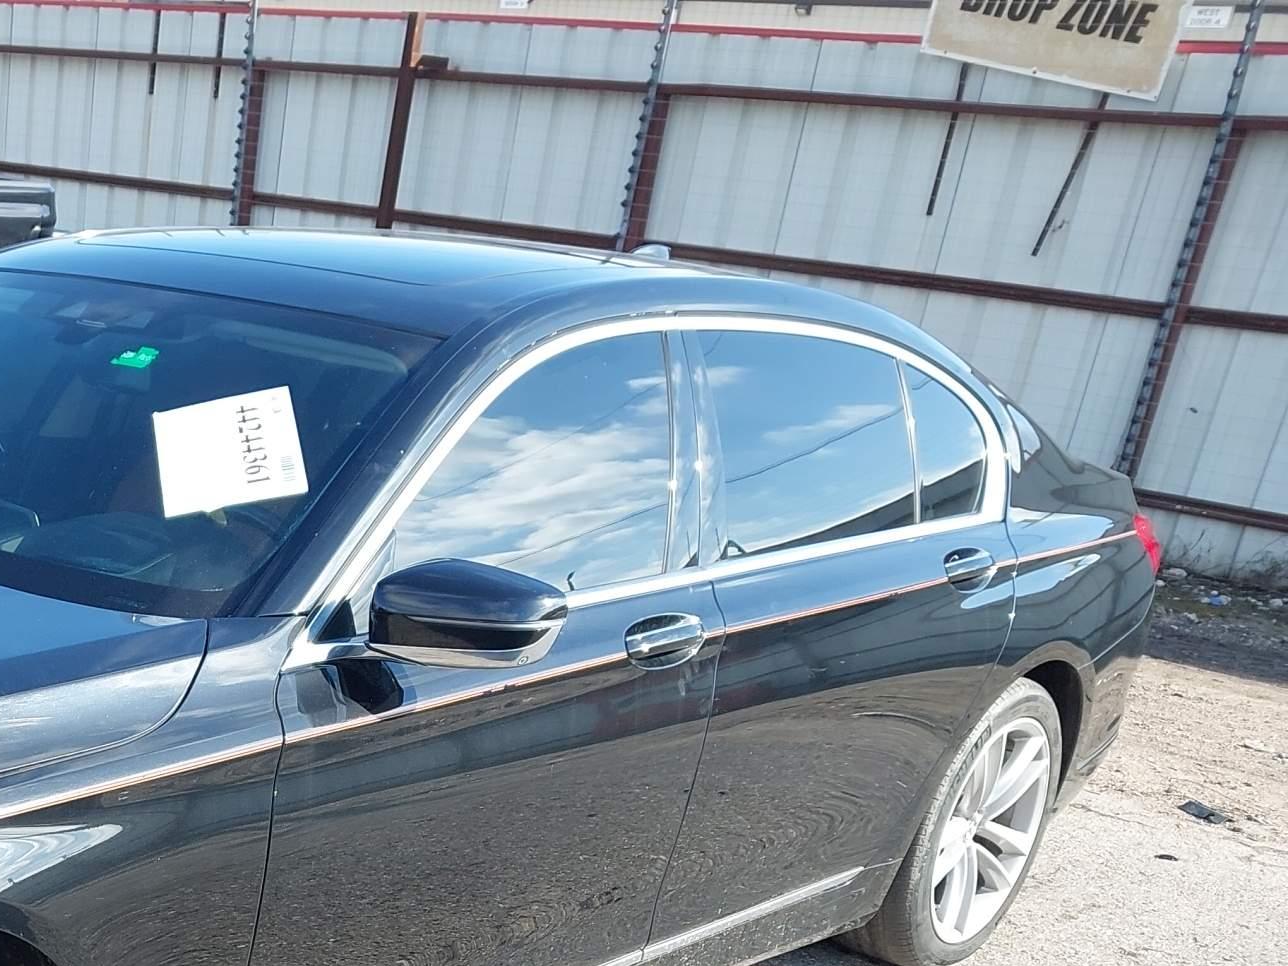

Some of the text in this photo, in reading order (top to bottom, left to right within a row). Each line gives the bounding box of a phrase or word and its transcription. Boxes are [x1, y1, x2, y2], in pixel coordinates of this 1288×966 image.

[960, 0, 1159, 44] OP ZONE
[235, 405, 272, 484] 44244361
